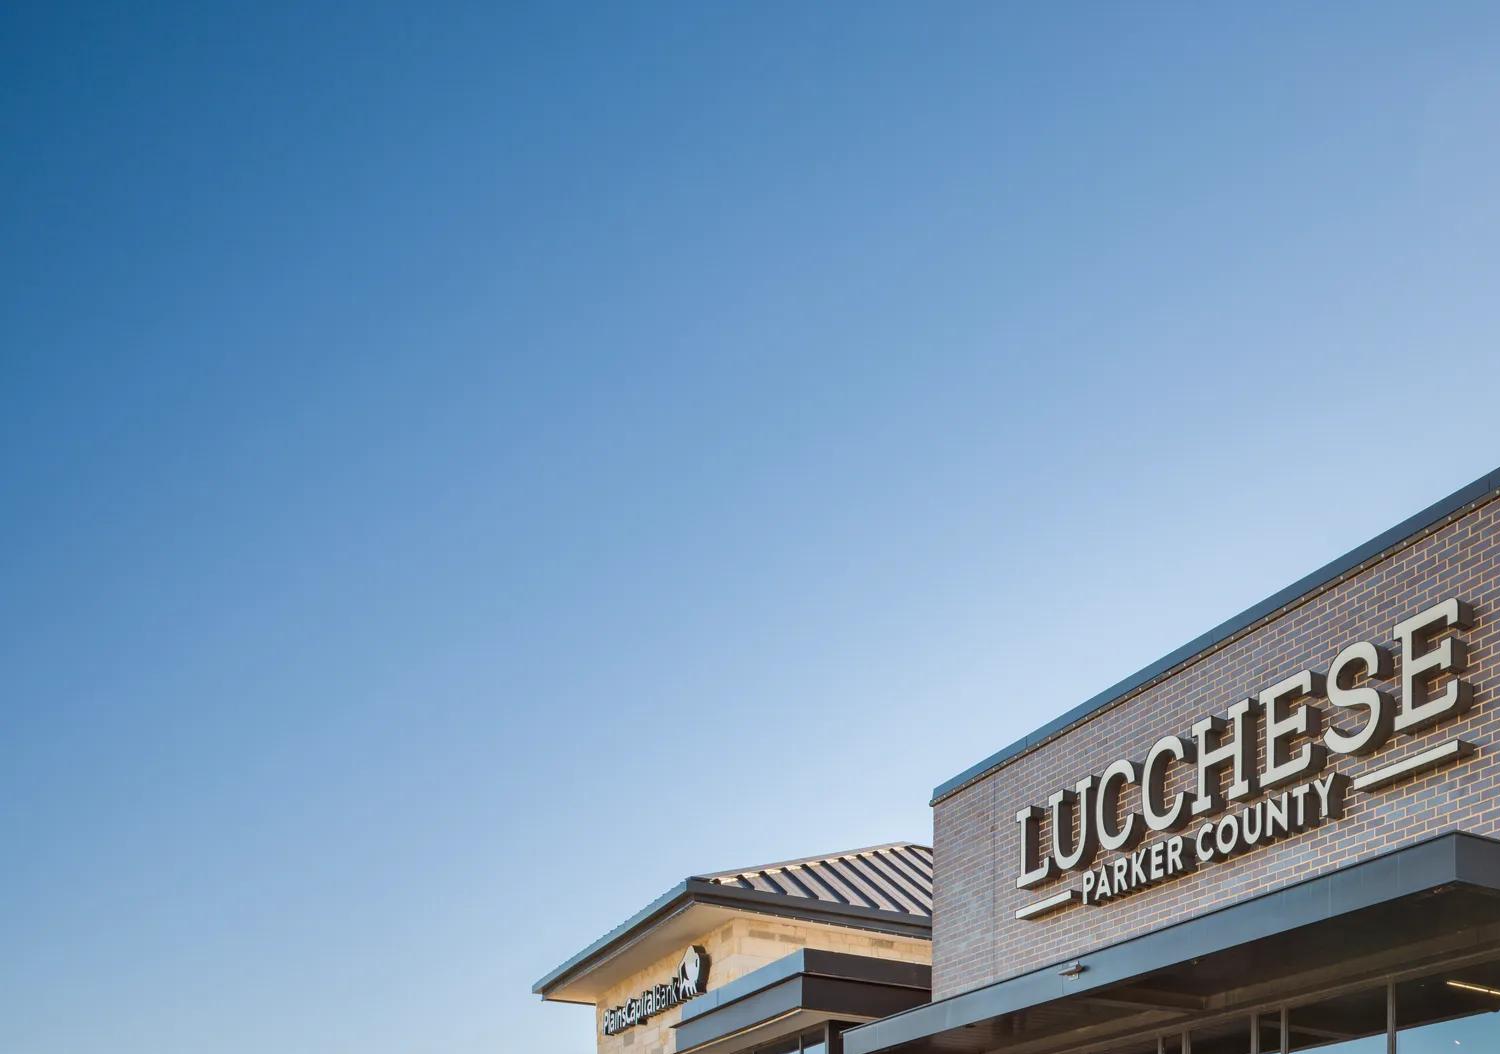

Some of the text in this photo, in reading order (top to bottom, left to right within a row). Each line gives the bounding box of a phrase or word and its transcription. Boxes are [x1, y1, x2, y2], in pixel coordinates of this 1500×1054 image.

[1015, 597, 1466, 890] LUCCHESE
[1082, 772, 1338, 905] PARKER COUNTY
